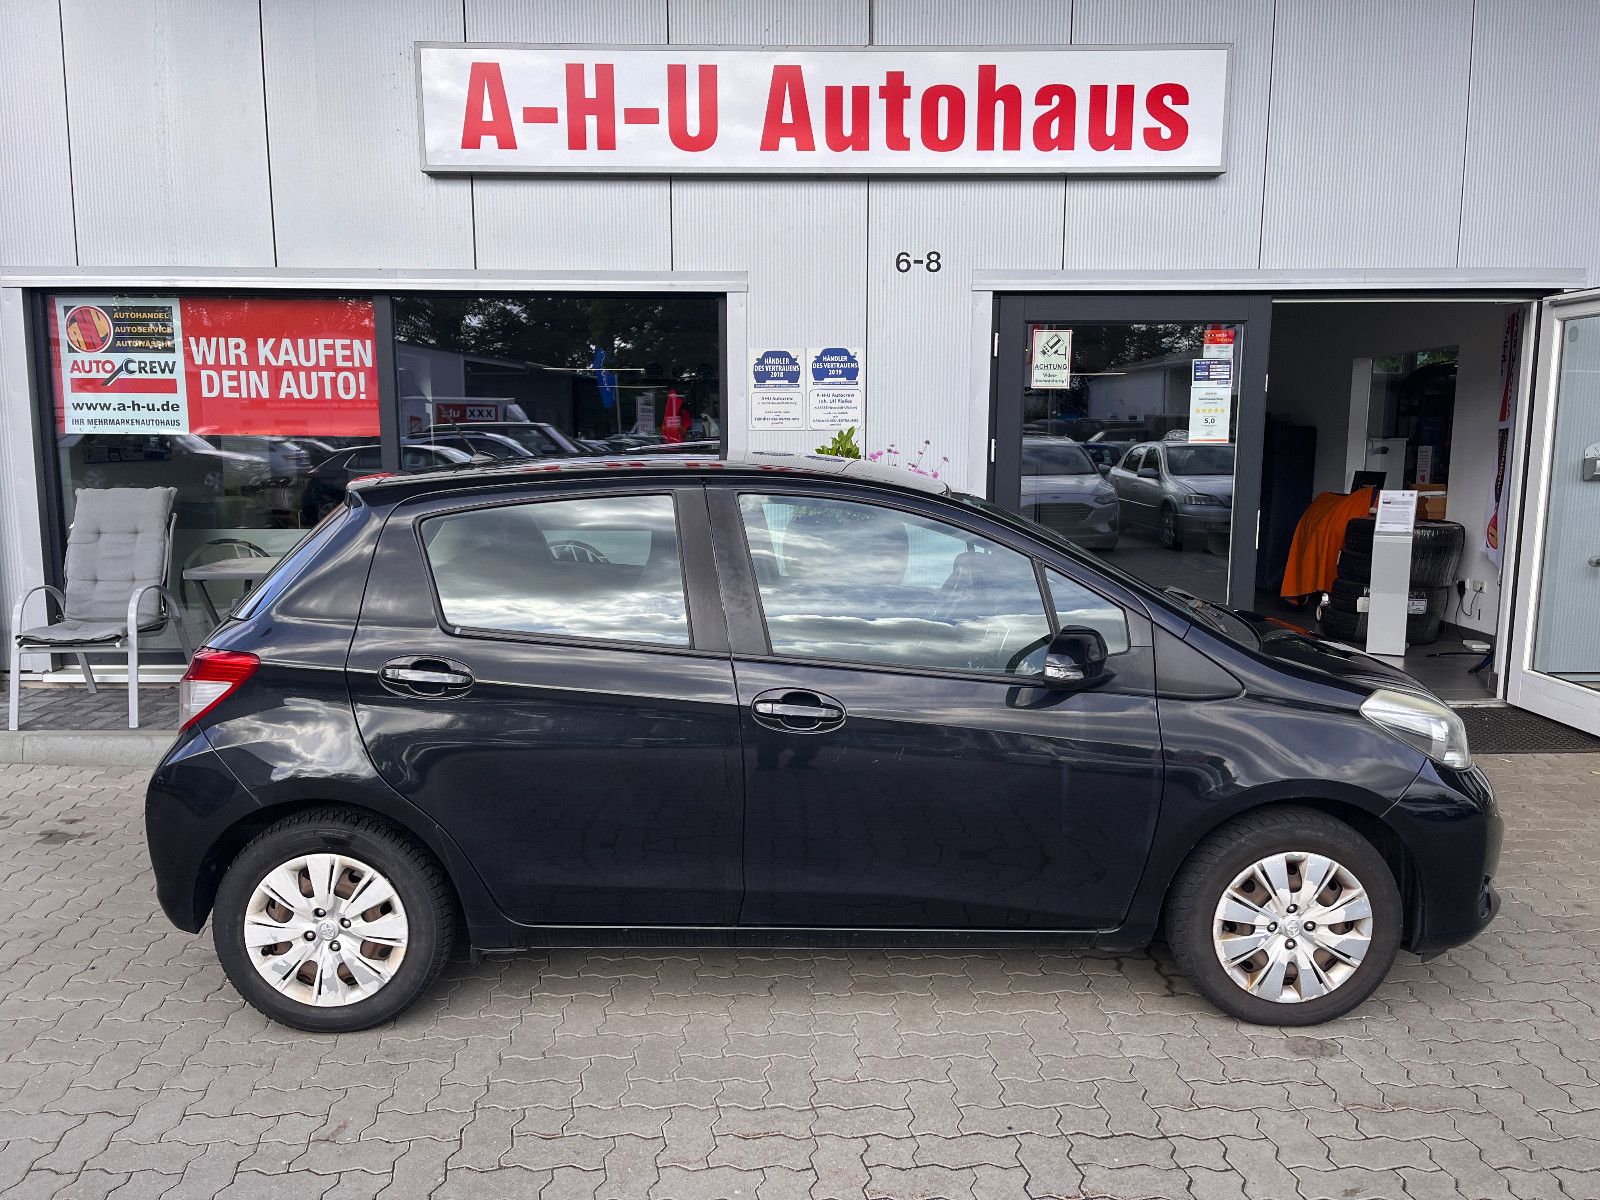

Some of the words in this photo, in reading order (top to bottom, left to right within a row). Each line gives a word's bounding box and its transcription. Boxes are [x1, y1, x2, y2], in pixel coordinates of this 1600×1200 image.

[460, 61, 718, 152] A-H-U
[759, 64, 1190, 152] Autohaus
[895, 251, 941, 273] 6-8
[113, 312, 170, 320] AUTOHANDEL
[188, 336, 249, 366] WIR
[257, 337, 373, 367] KAUFEN
[70, 359, 116, 374] AUTO
[123, 358, 177, 375] CREW
[764, 357, 790, 365] HÄNDLER
[200, 369, 270, 399] DEIN
[279, 370, 367, 400] AUTO!
[72, 400, 180, 412] www.a-h-u.de
[72, 418, 85, 426] IHR
[87, 418, 181, 427] MEHRMARKENAUTOHAUS
[1204, 417, 1216, 425] 5,0
